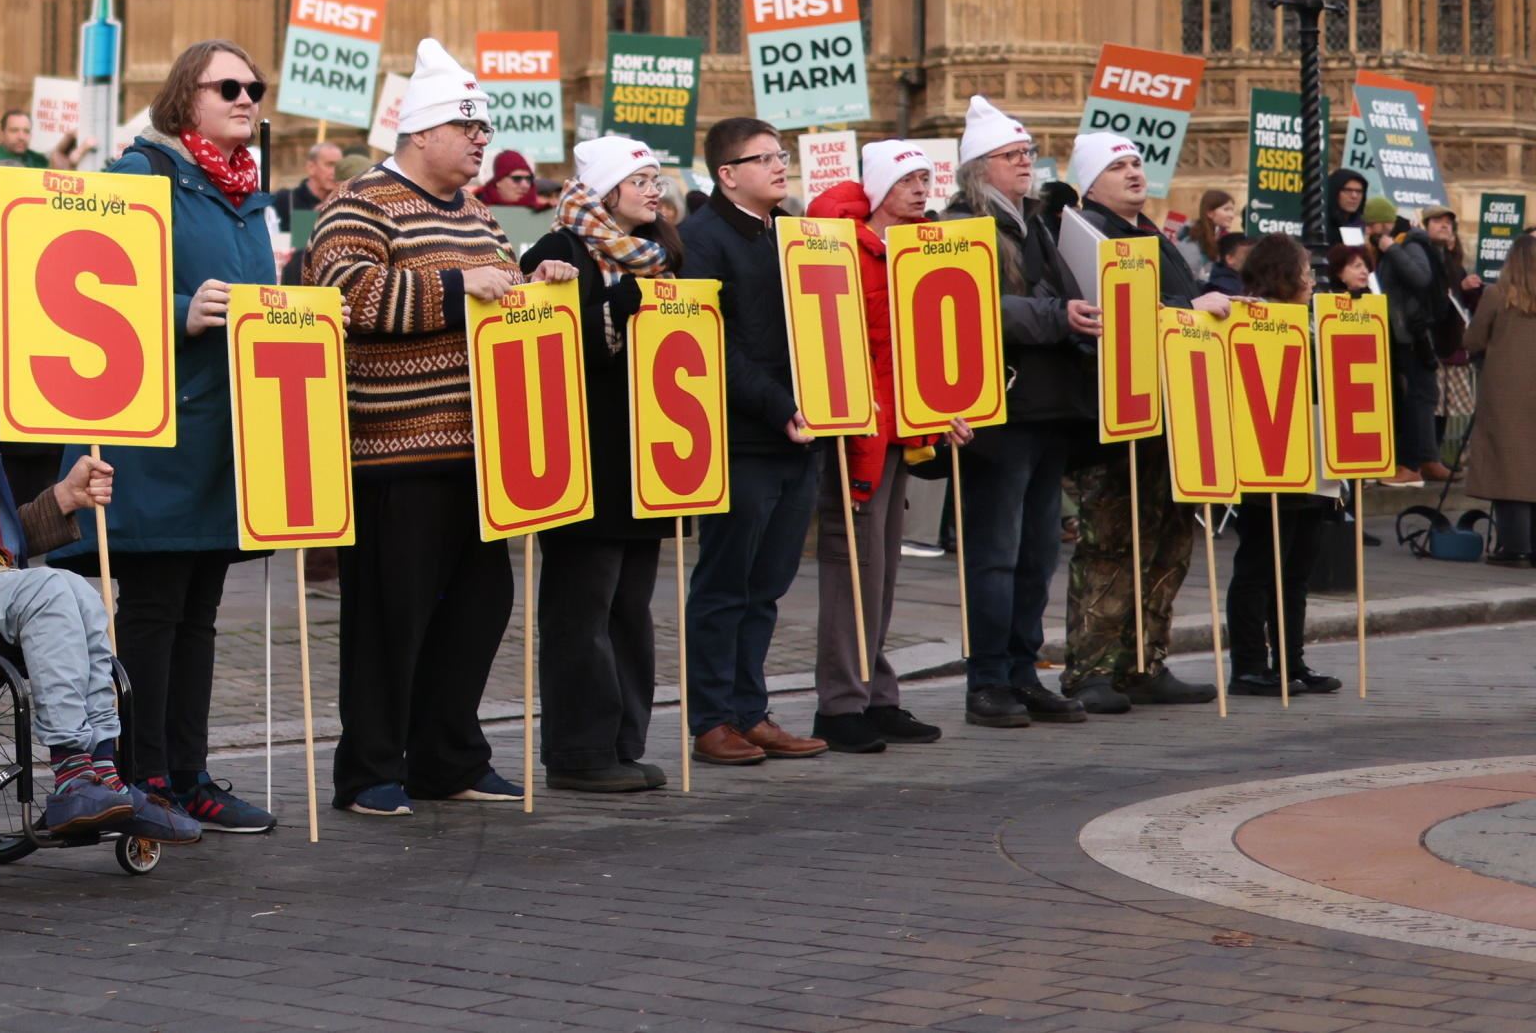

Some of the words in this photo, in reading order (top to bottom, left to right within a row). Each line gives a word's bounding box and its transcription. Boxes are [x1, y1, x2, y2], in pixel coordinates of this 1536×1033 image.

[294, 39, 328, 61] DO
[335, 47, 369, 70] NO
[760, 42, 802, 66] DO
[811, 36, 852, 60] NO
[481, 50, 553, 74] FIRST
[613, 54, 655, 70] DON'T
[657, 57, 694, 73] OPEN
[290, 63, 367, 95] HARM
[611, 70, 635, 85] THE
[637, 71, 674, 87] DOOR
[675, 73, 694, 89] TO
[763, 63, 856, 95] HARM
[1100, 65, 1191, 101] FIRST
[40, 99, 57, 109] KILL
[63, 101, 78, 110] THE
[523, 92, 553, 109] NO
[612, 85, 690, 106] ASSISTED
[614, 105, 685, 126] SUICIDE
[1371, 100, 1407, 116] CHOICE
[40, 122, 56, 132] THE
[1090, 109, 1131, 132] DO
[1136, 117, 1176, 139] NO
[1256, 112, 1291, 132] DON'T
[1368, 114, 1390, 128] FOR
[1391, 116, 1399, 130] A
[1399, 117, 1418, 132] FEW
[809, 141, 846, 155] PLEASE
[1254, 130, 1275, 146] THE
[1278, 132, 1303, 150] DOO
[816, 155, 842, 167] VOTE
[934, 162, 951, 172] THE
[1257, 148, 1303, 171] ASSIST
[1379, 149, 1430, 167] COERCION
[810, 167, 851, 179] AGAINST
[935, 174, 954, 184] NOT
[1258, 170, 1303, 193] SUICI
[1382, 164, 1404, 178] FOR
[1405, 166, 1434, 181] MANY
[49, 174, 79, 194] not
[52, 192, 97, 212] dead
[100, 197, 126, 217] yet
[1490, 202, 1516, 214] CHOICE
[1484, 212, 1498, 223] FOR
[1498, 213, 1505, 224] A
[1505, 213, 1520, 225] FEW
[802, 221, 818, 236] not
[920, 227, 939, 240] not
[807, 236, 828, 251] dead
[829, 238, 840, 253] yet
[923, 238, 951, 255] dead
[954, 240, 969, 255] yet
[1117, 243, 1129, 256] not
[1119, 256, 1135, 270] dead
[1136, 255, 1145, 271] yet
[1480, 249, 1495, 260] FOR
[264, 292, 283, 308] not
[502, 292, 523, 307] not
[657, 283, 674, 299] not
[660, 299, 685, 316] dead
[687, 301, 700, 318] yet
[1336, 297, 1351, 309] not
[267, 307, 297, 325] dead
[299, 310, 315, 329] yet
[506, 306, 536, 325] dead
[538, 303, 553, 325] yet
[1178, 312, 1192, 326] not
[1249, 306, 1266, 319] not
[1340, 309, 1357, 322] dead
[1358, 310, 1370, 324] yet
[29, 229, 144, 421] S
[1182, 324, 1201, 338] dead
[1201, 327, 1212, 342] yet
[1252, 319, 1275, 332] dead
[1276, 320, 1288, 335] yet
[798, 264, 849, 417] T
[912, 267, 984, 413] O
[1115, 283, 1151, 425] L
[1331, 334, 1382, 463] E
[651, 330, 712, 495] S
[1190, 351, 1217, 486] I
[1234, 343, 1302, 477] V
[492, 332, 571, 510] U
[253, 342, 326, 527] T
